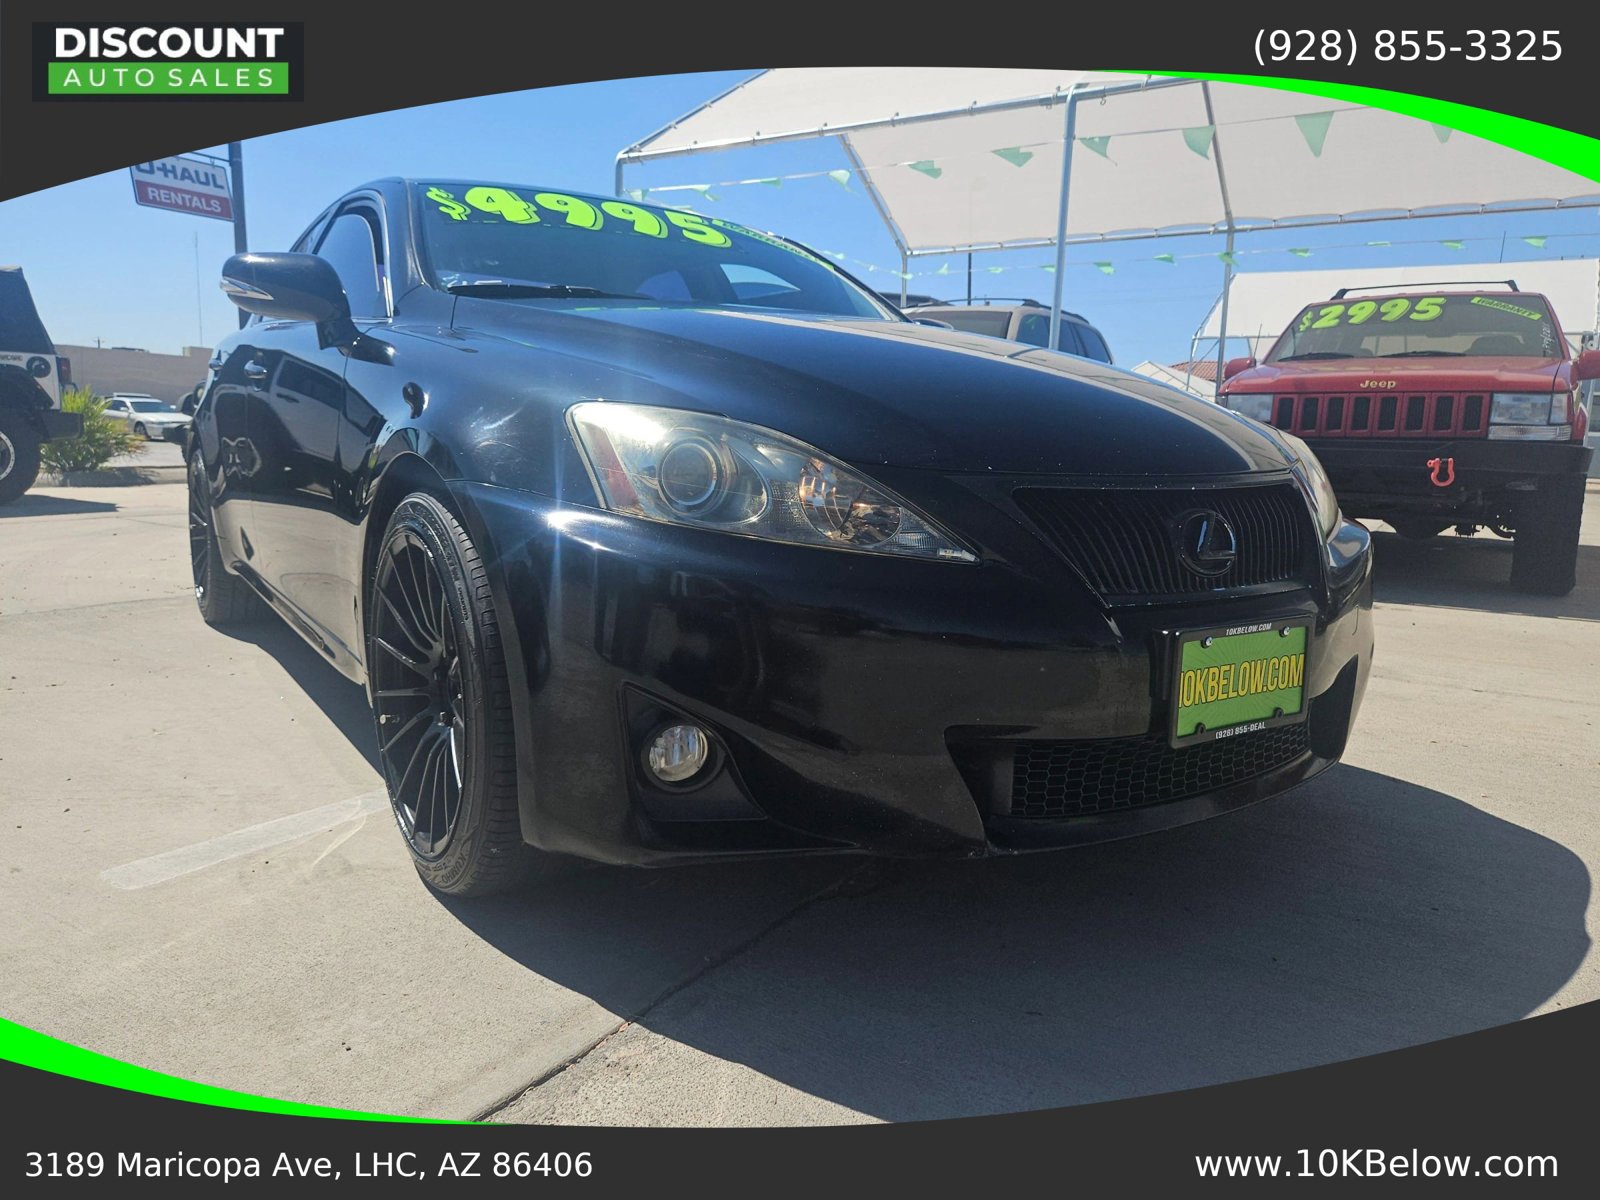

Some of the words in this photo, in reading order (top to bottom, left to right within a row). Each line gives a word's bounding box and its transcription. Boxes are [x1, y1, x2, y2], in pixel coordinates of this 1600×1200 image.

[147, 187, 222, 213] RENTALS
[427, 186, 732, 248] $4995
[1300, 296, 1447, 331] $2995
[1359, 379, 1397, 389] Jeep
[1226, 622, 1272, 636] 10KBELOW.COM
[1215, 728, 1234, 740] (928)
[1234, 721, 1266, 735] 855-DEAL
